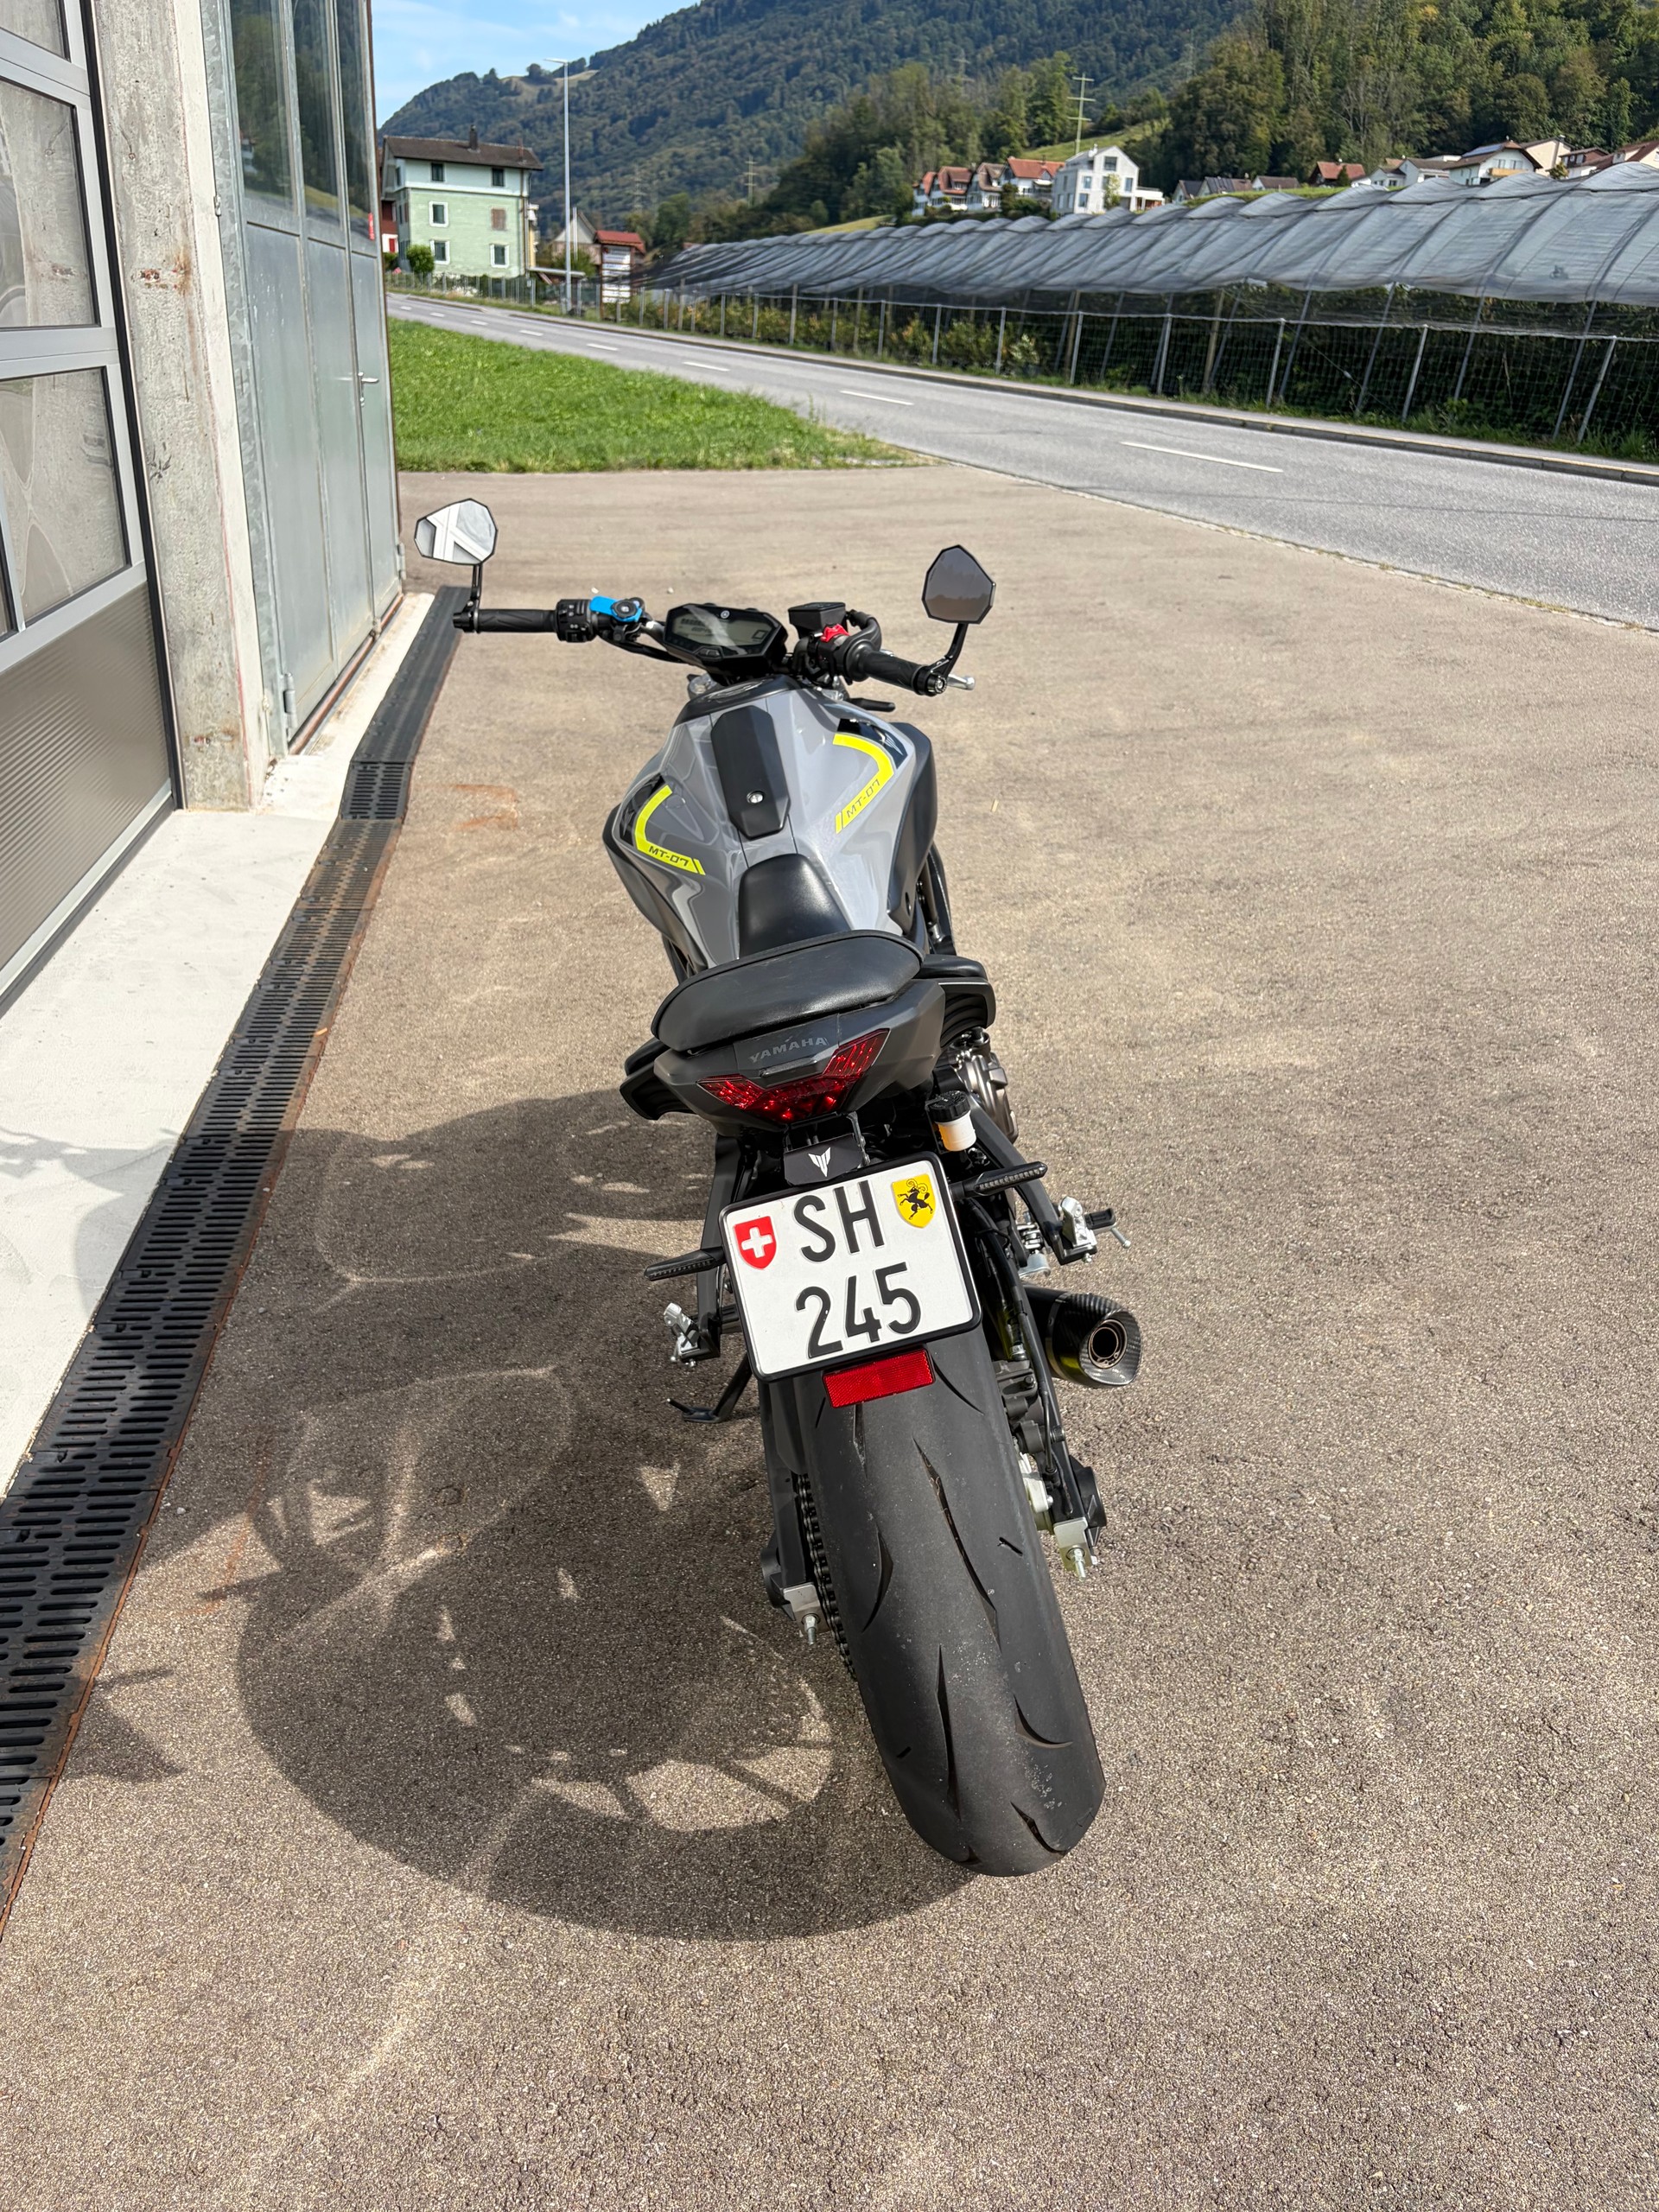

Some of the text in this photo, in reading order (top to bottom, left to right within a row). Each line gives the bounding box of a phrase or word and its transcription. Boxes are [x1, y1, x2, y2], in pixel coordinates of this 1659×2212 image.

[846, 779, 880, 818] MT-07
[648, 845, 690, 867] MT-07
[748, 1037, 827, 1064] YAMAHA
[793, 1179, 885, 1262] SH
[795, 1262, 922, 1359] 245
